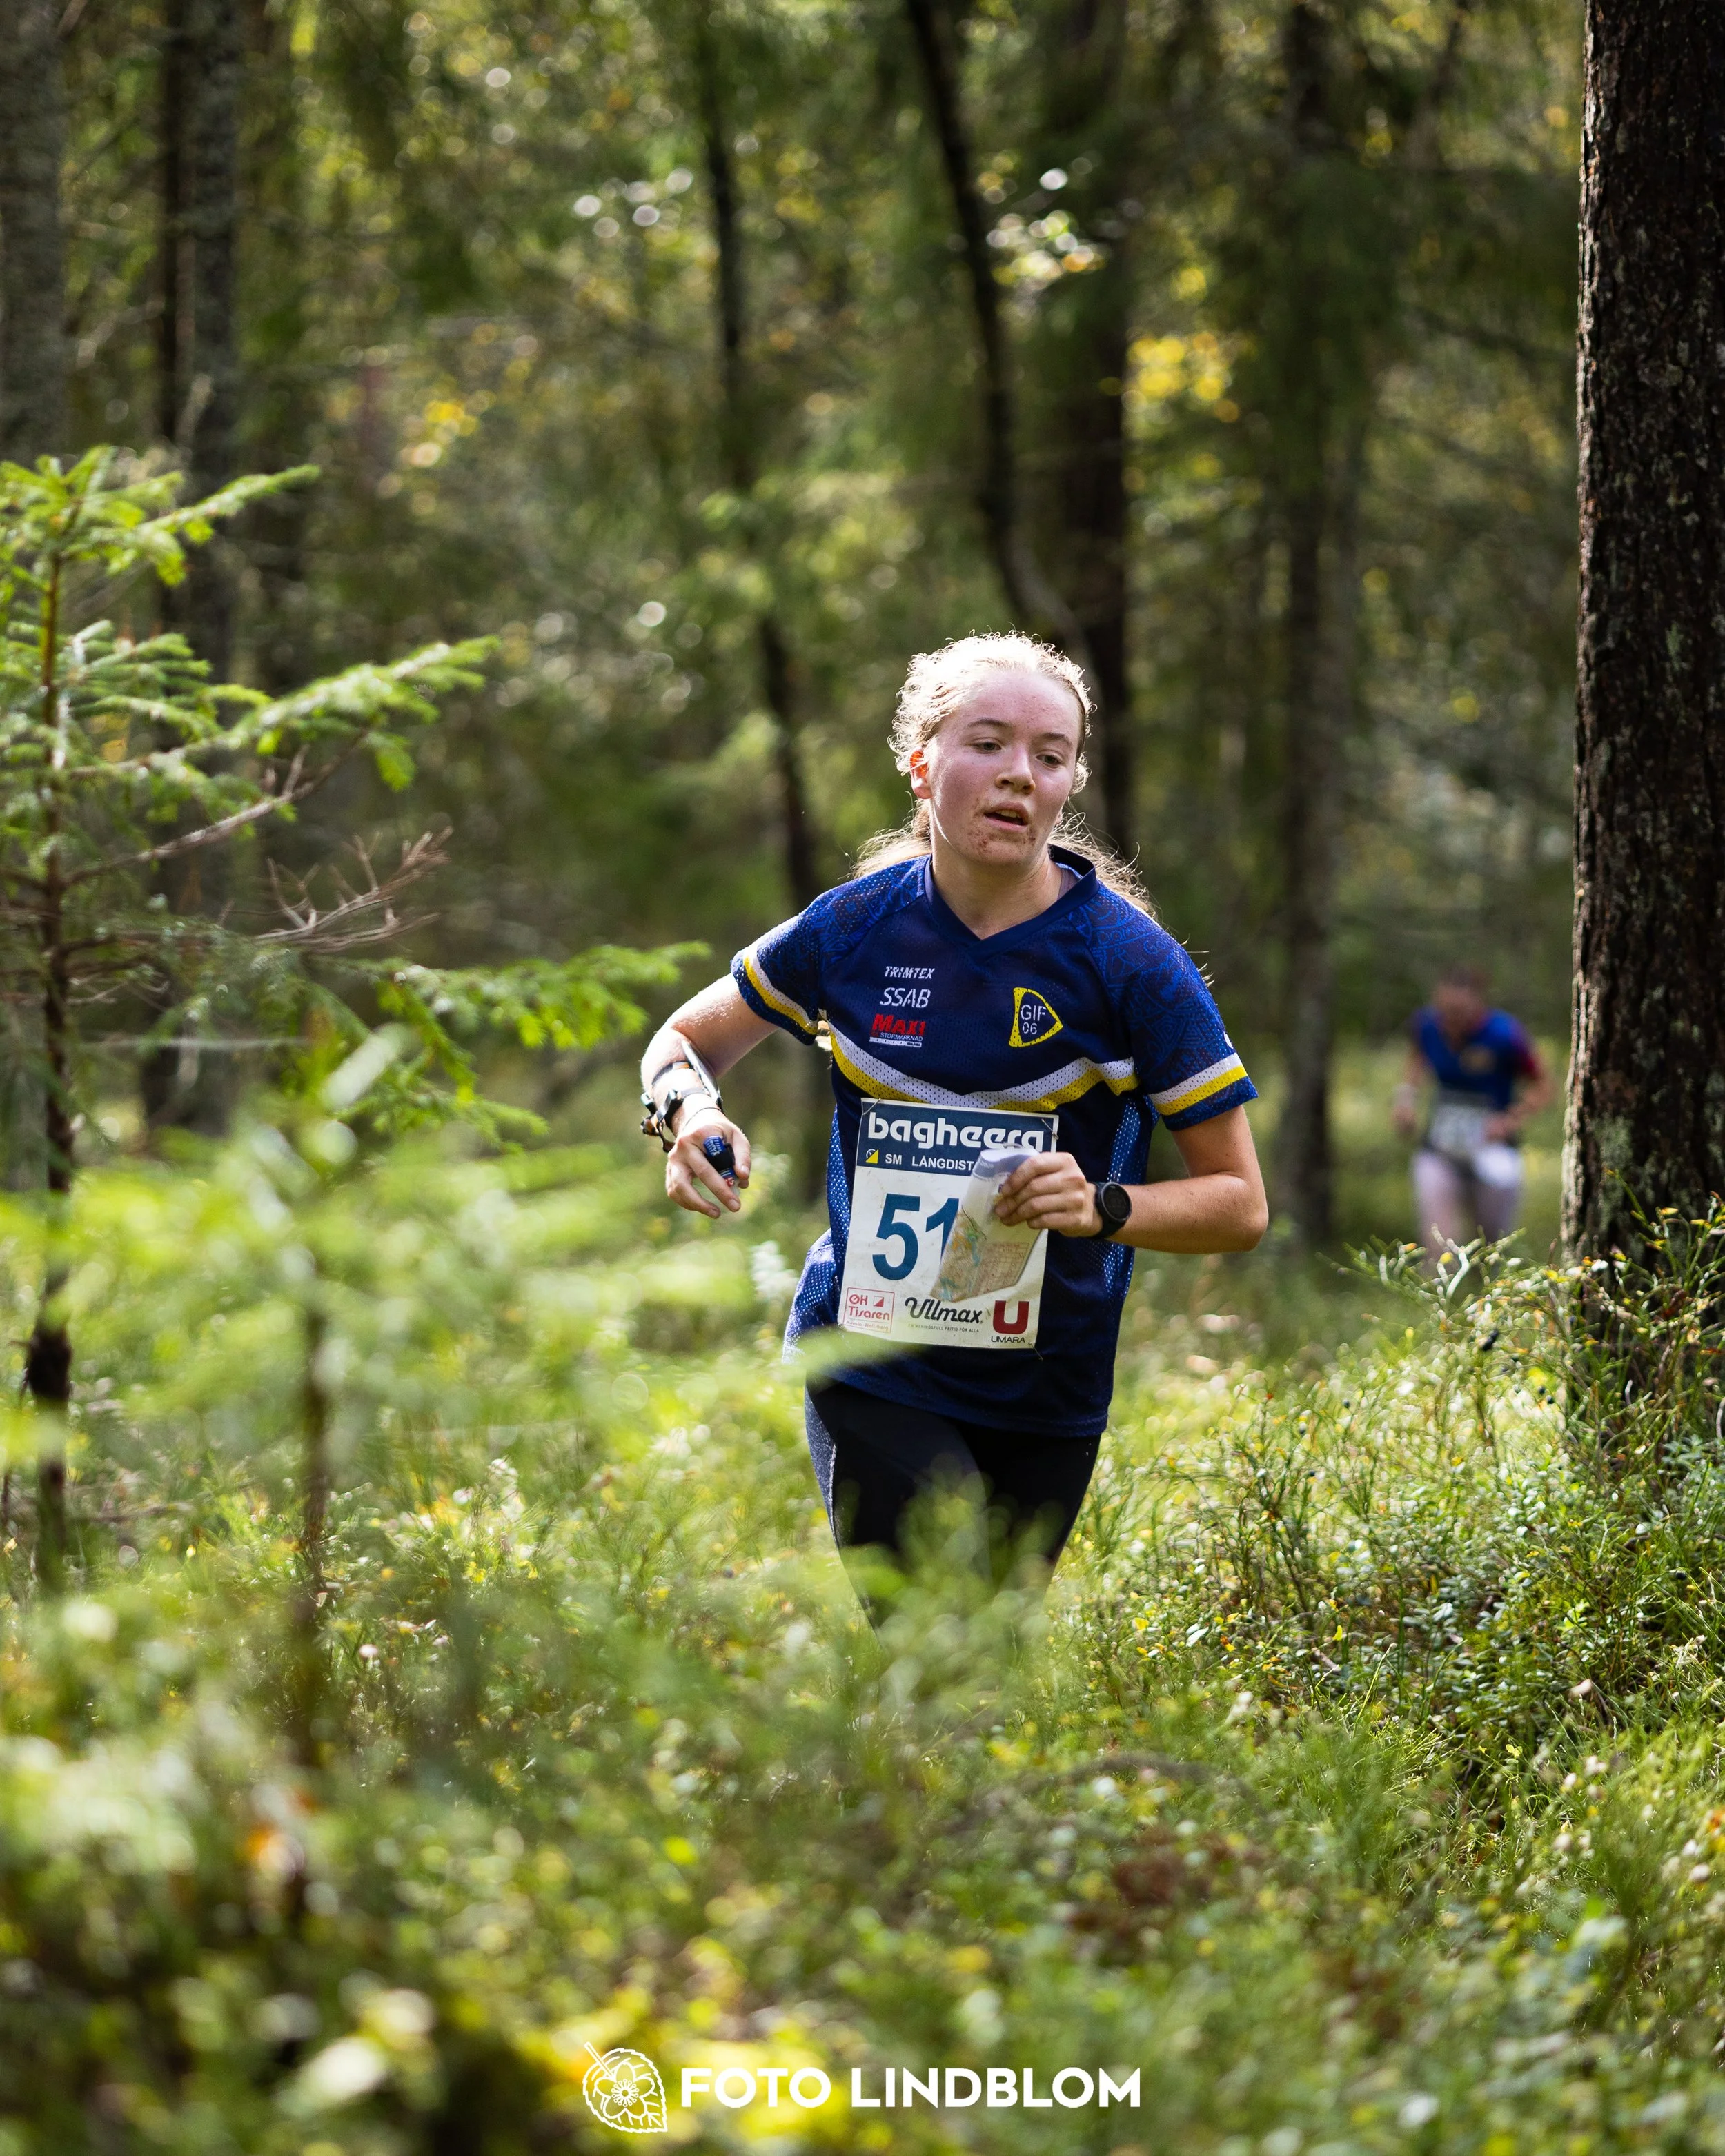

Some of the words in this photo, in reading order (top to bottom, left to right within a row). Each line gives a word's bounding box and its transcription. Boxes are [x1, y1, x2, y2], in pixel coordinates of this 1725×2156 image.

[884, 966, 936, 980] TRIMTEX
[879, 987, 931, 1008] SSAB
[1020, 1004, 1047, 1022] GIF
[880, 1031, 923, 1042] STORMARKNAD
[1022, 1022, 1038, 1035] 06
[867, 1111, 1045, 1153] bagheera
[885, 1153, 903, 1165] SM
[911, 1154, 974, 1171] LÅNGDIST
[871, 1193, 960, 1281] 51
[848, 1305, 890, 1321] Tisaren
[905, 1297, 983, 1323] Ullmax
[992, 1300, 1029, 1335] U
[991, 1334, 1026, 1343] UMARA
